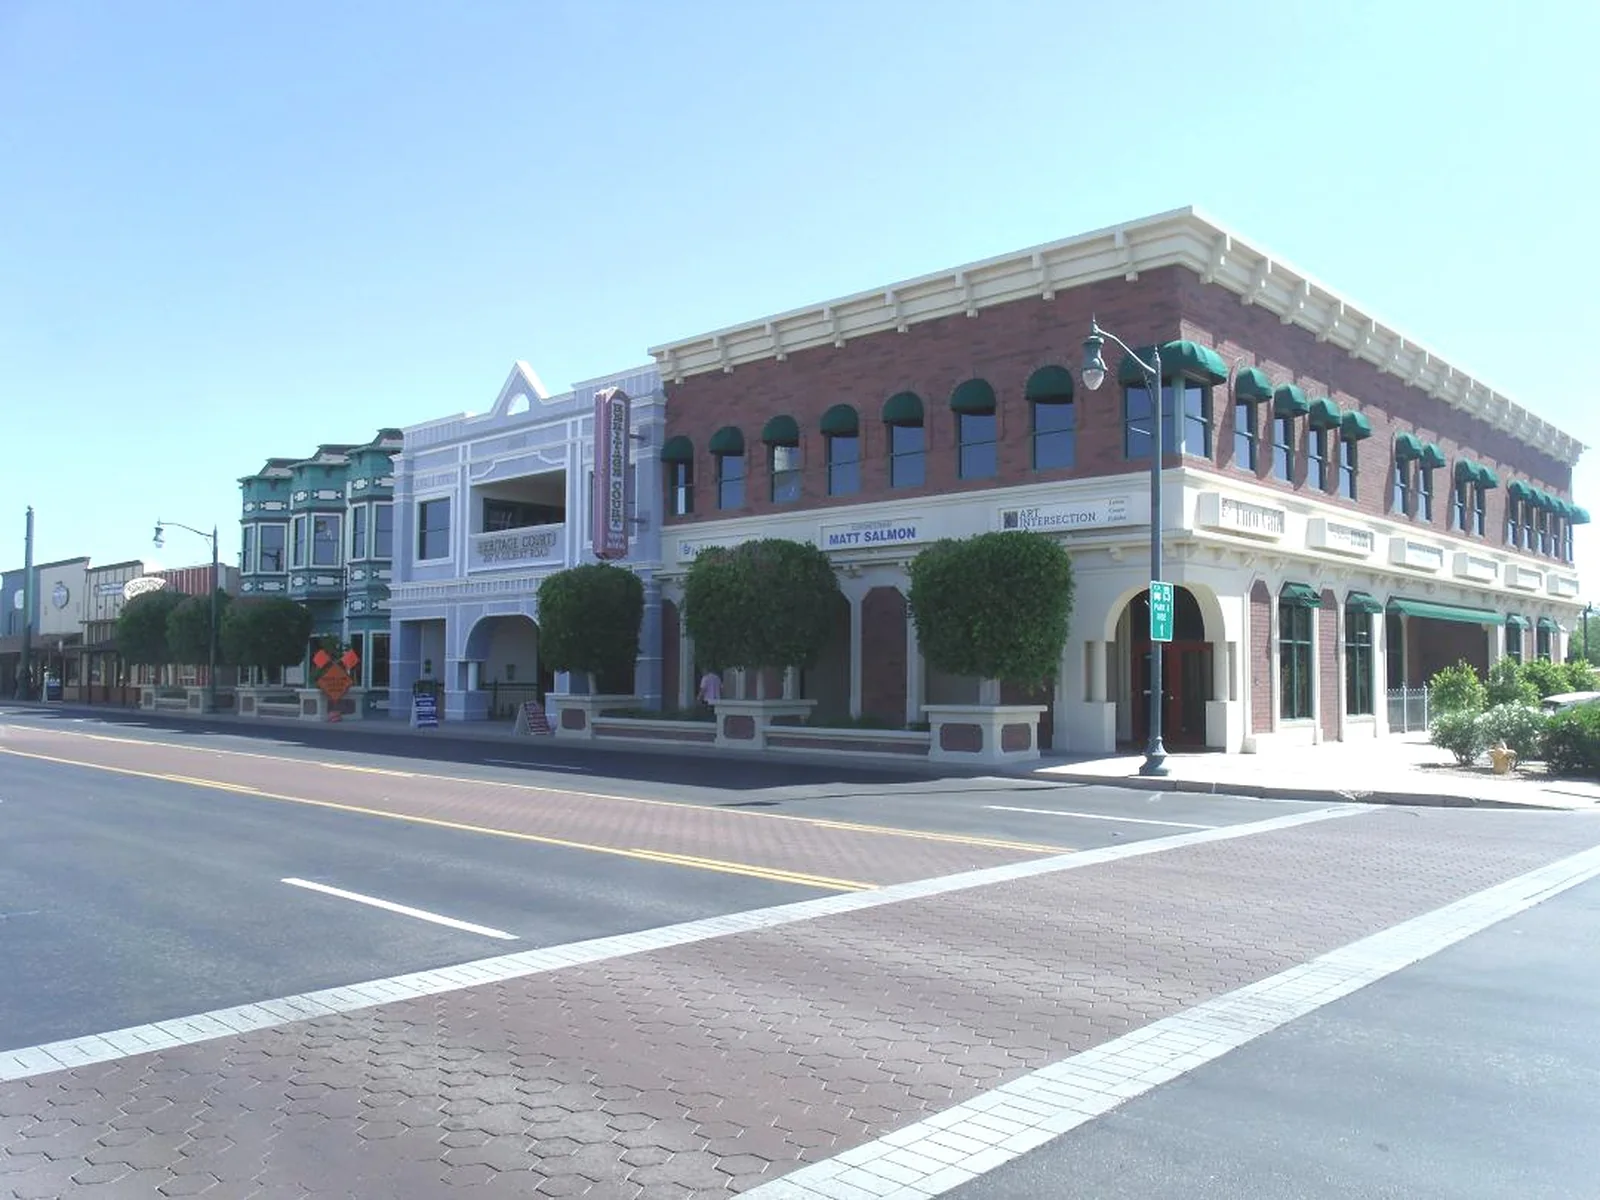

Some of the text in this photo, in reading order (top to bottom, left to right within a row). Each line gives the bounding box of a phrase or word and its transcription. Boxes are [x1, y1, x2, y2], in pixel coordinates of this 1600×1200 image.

[1019, 512, 1096, 528] INTERSECTION
[1020, 508, 1040, 518] ART
[829, 526, 916, 546] MATT SALMON
